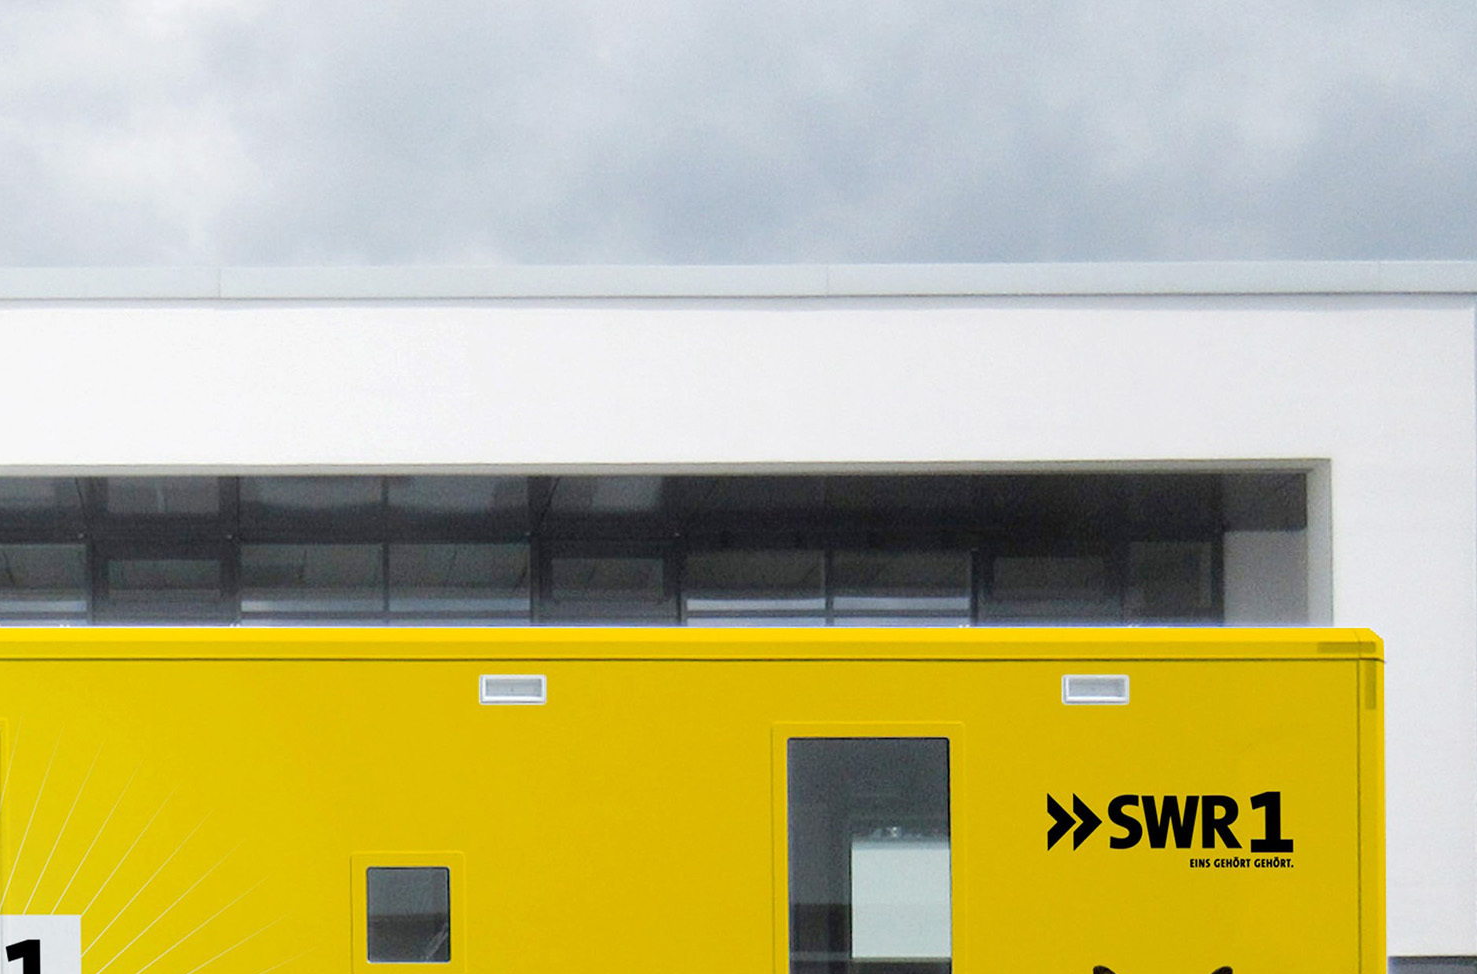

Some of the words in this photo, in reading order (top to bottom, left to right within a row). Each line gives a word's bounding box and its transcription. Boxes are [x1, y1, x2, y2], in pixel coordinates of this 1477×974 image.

[1189, 858, 1211, 869] EINS
[1213, 856, 1251, 869] GEHÖRT
[1253, 856, 1294, 869] GEHÖRT.
